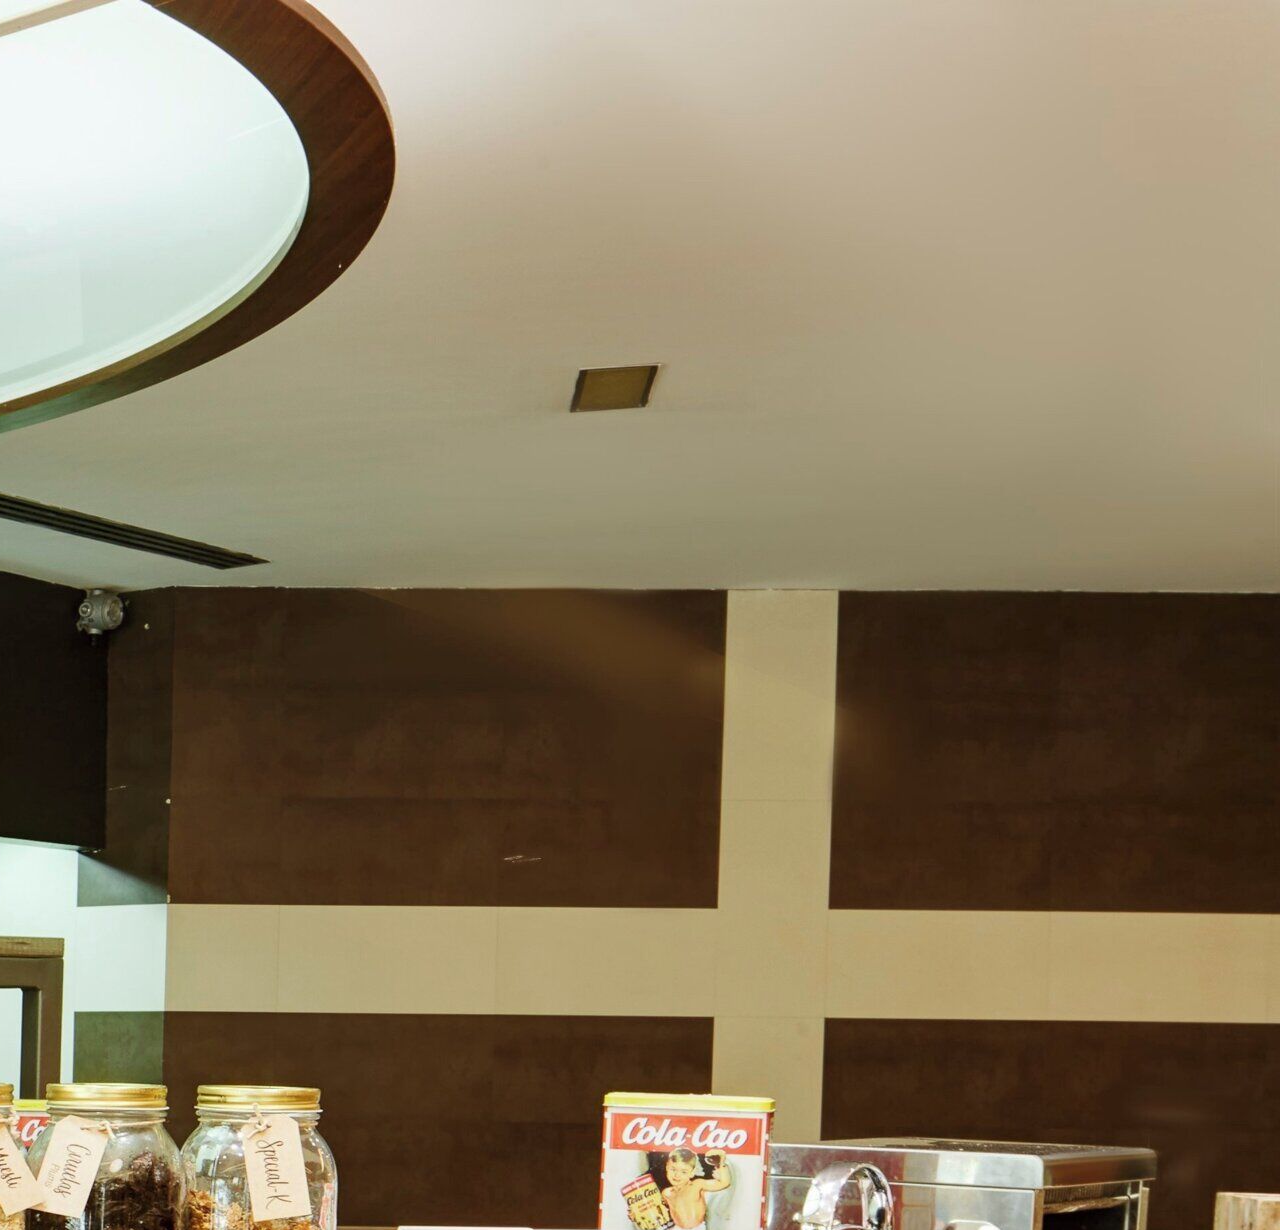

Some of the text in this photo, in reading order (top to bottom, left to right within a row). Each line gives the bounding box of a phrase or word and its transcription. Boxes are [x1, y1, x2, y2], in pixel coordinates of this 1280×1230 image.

[622, 1117, 747, 1149] Cola-Cao
[53, 1143, 92, 1198] Ciruelas
[255, 1140, 293, 1209] Special-K
